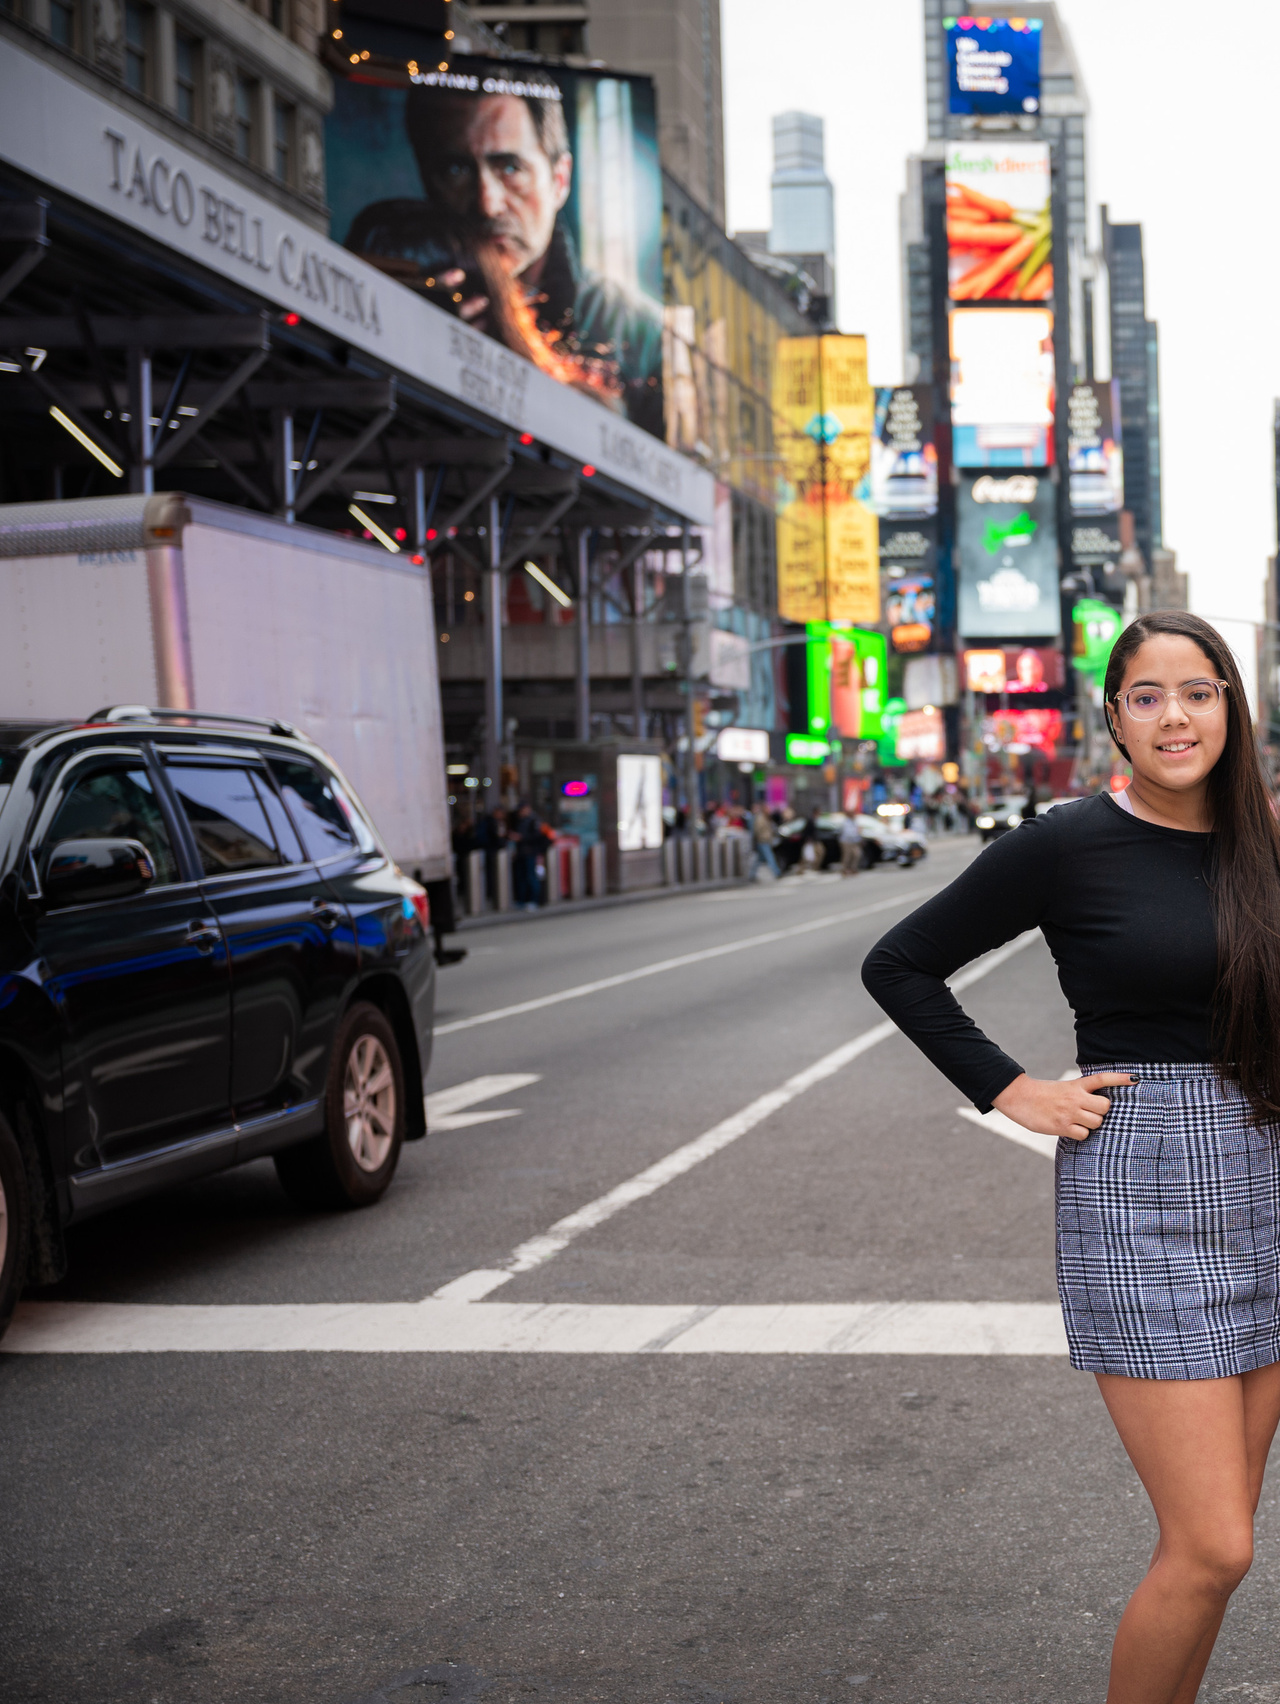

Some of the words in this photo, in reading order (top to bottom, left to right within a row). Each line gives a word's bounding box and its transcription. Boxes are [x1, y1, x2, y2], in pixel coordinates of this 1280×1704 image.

[103, 127, 196, 227] TACO
[199, 185, 272, 273] BELL
[278, 232, 383, 337] CANTINA
